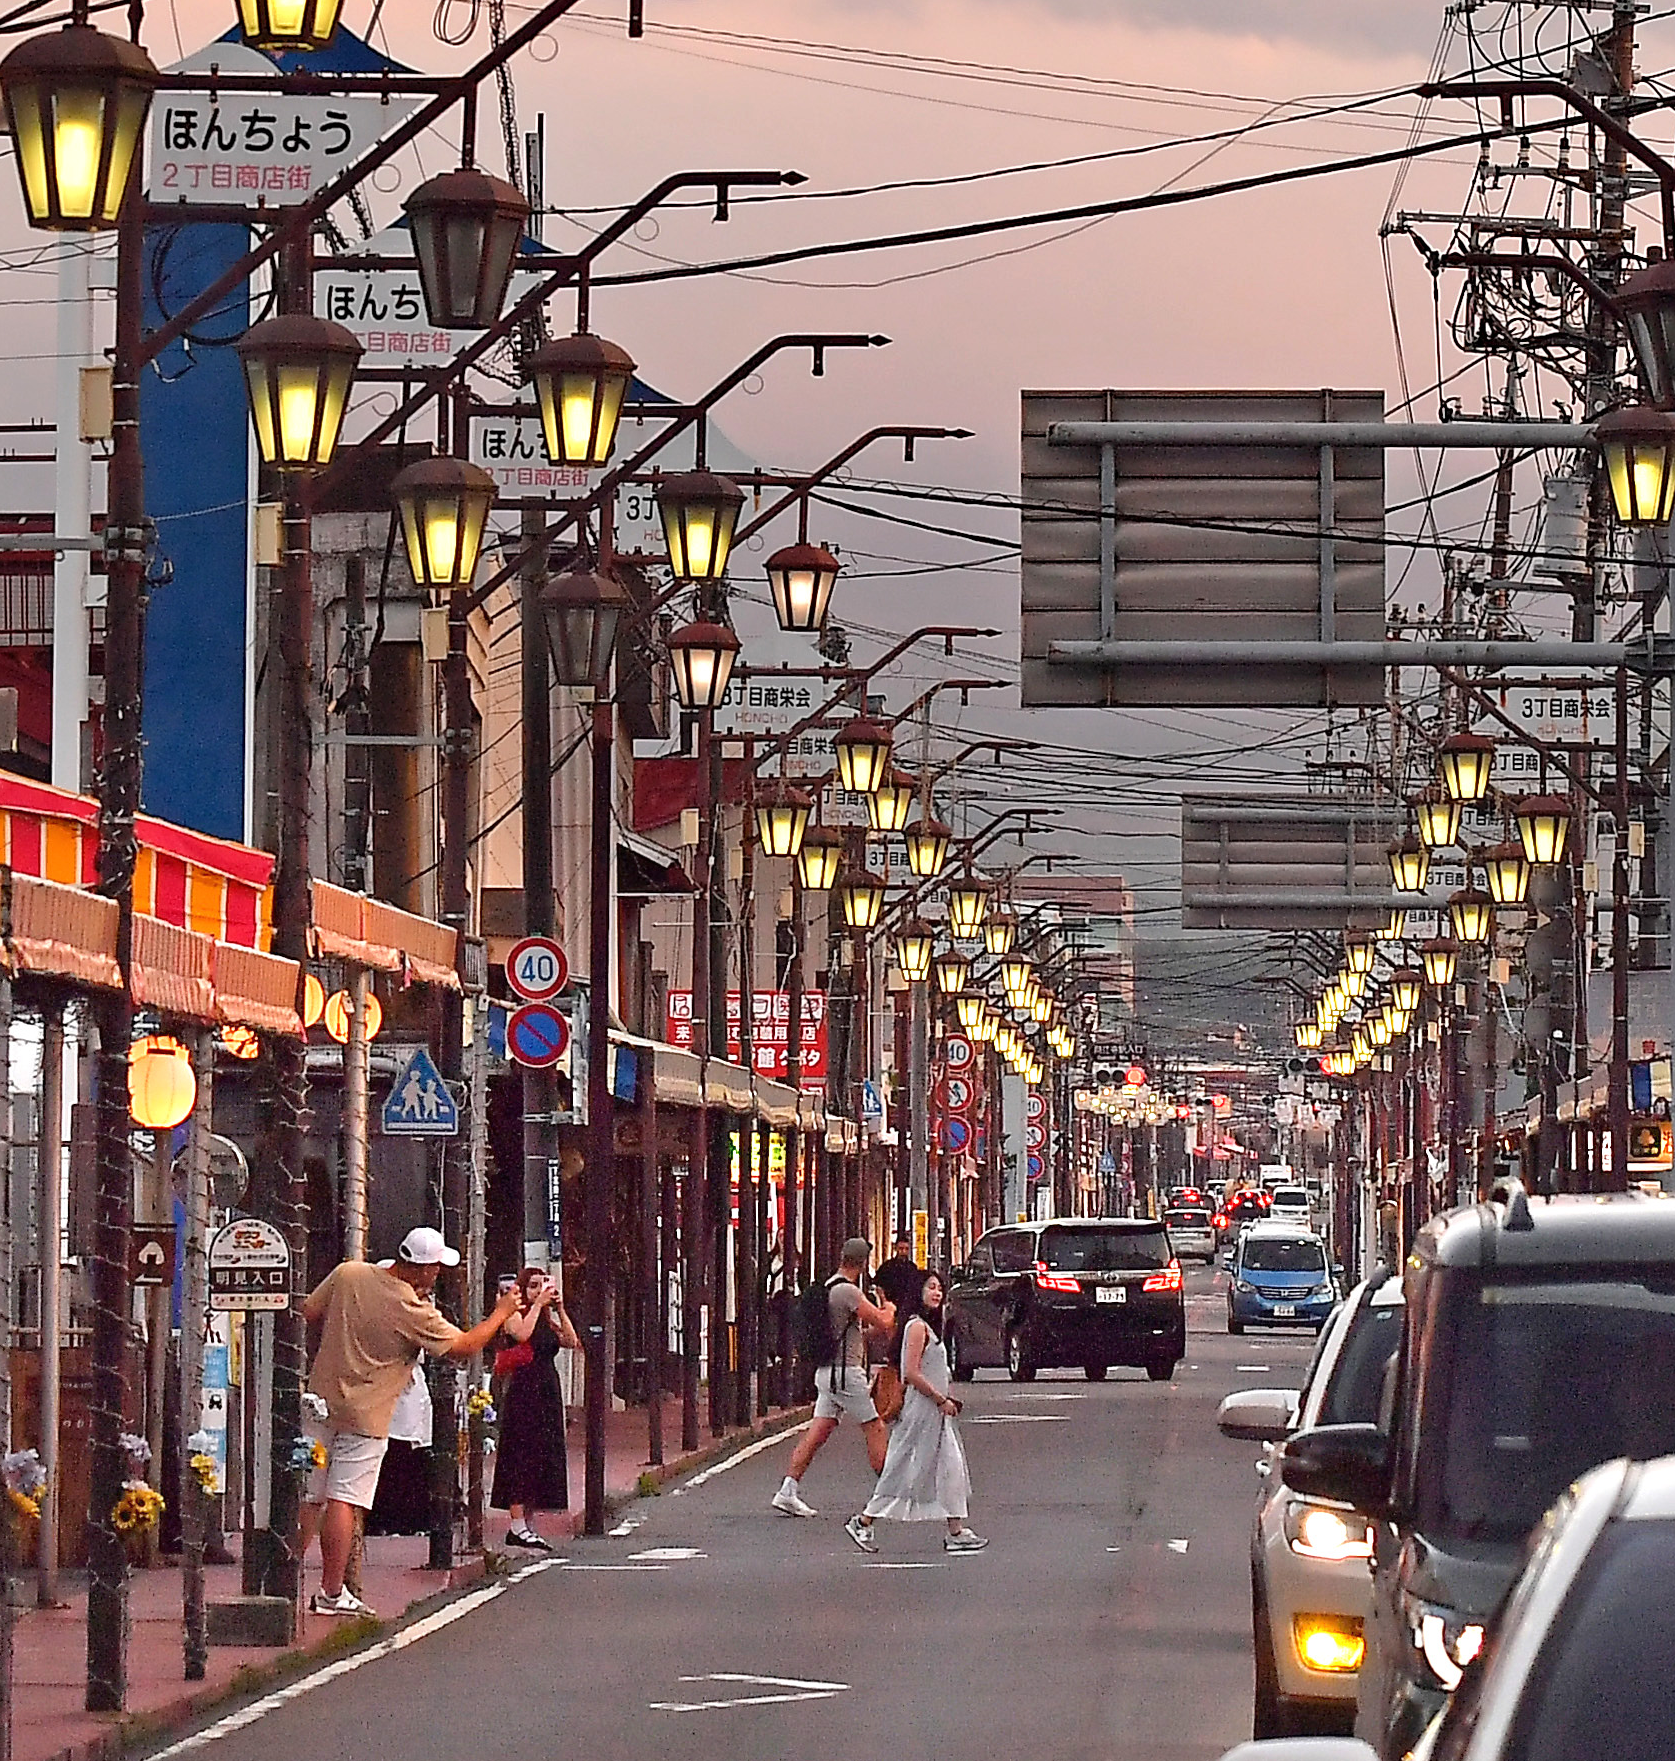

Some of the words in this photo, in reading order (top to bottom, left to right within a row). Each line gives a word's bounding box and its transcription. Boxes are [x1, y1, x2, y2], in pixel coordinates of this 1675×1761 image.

[163, 107, 354, 156] ほんちょう
[162, 162, 313, 192] 2丁目商店街
[354, 331, 452, 354] 目商店街
[1492, 751, 1569, 773] 丁目商会
[521, 955, 554, 982] 40
[215, 1270, 284, 1286] 明見入口
